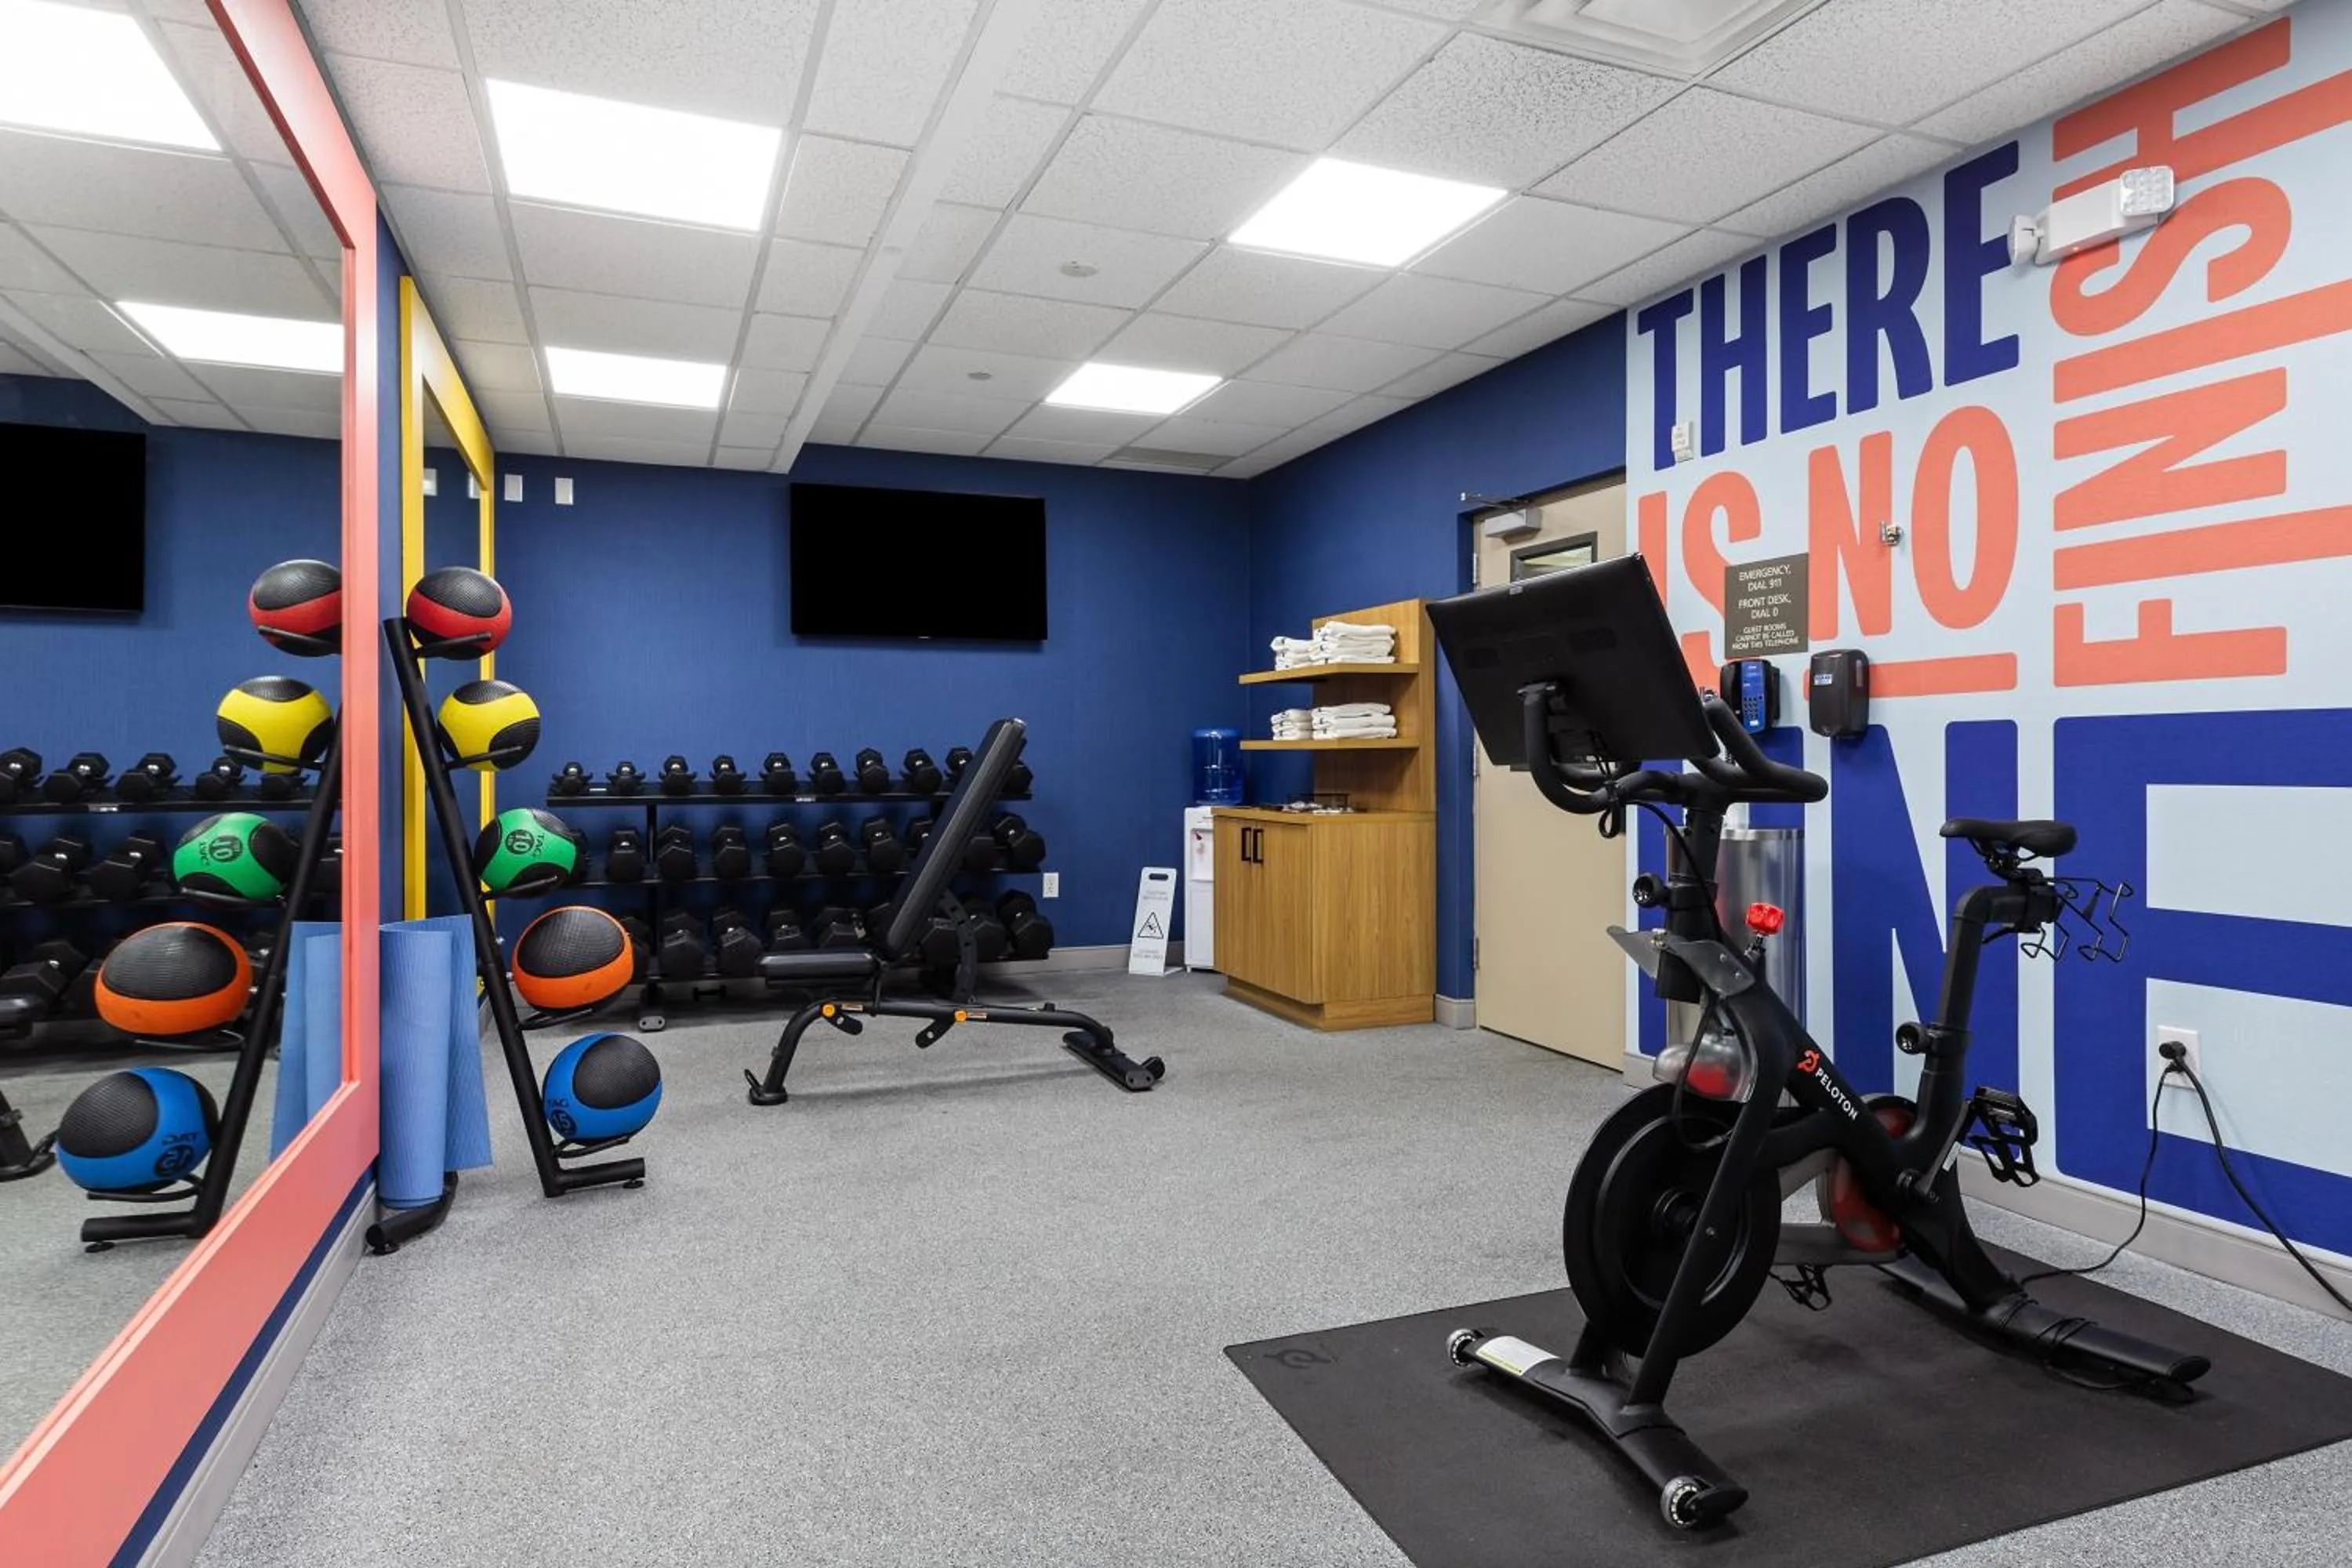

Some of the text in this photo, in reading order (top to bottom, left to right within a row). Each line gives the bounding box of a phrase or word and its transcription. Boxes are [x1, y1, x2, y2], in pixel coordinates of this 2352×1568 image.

[1638, 140, 2020, 472] THERE
[2049, 16, 2352, 688] FINISH
[1808, 405, 2020, 641] NO
[1738, 564, 1791, 581] EMERGENCY,
[1748, 578, 1782, 592] DIAL 911
[1738, 597, 1766, 609] FRONT
[1751, 608, 1770, 619] DIAL
[1637, 707, 2352, 1258] NE
[1815, 1067, 1858, 1120] PELOTON
